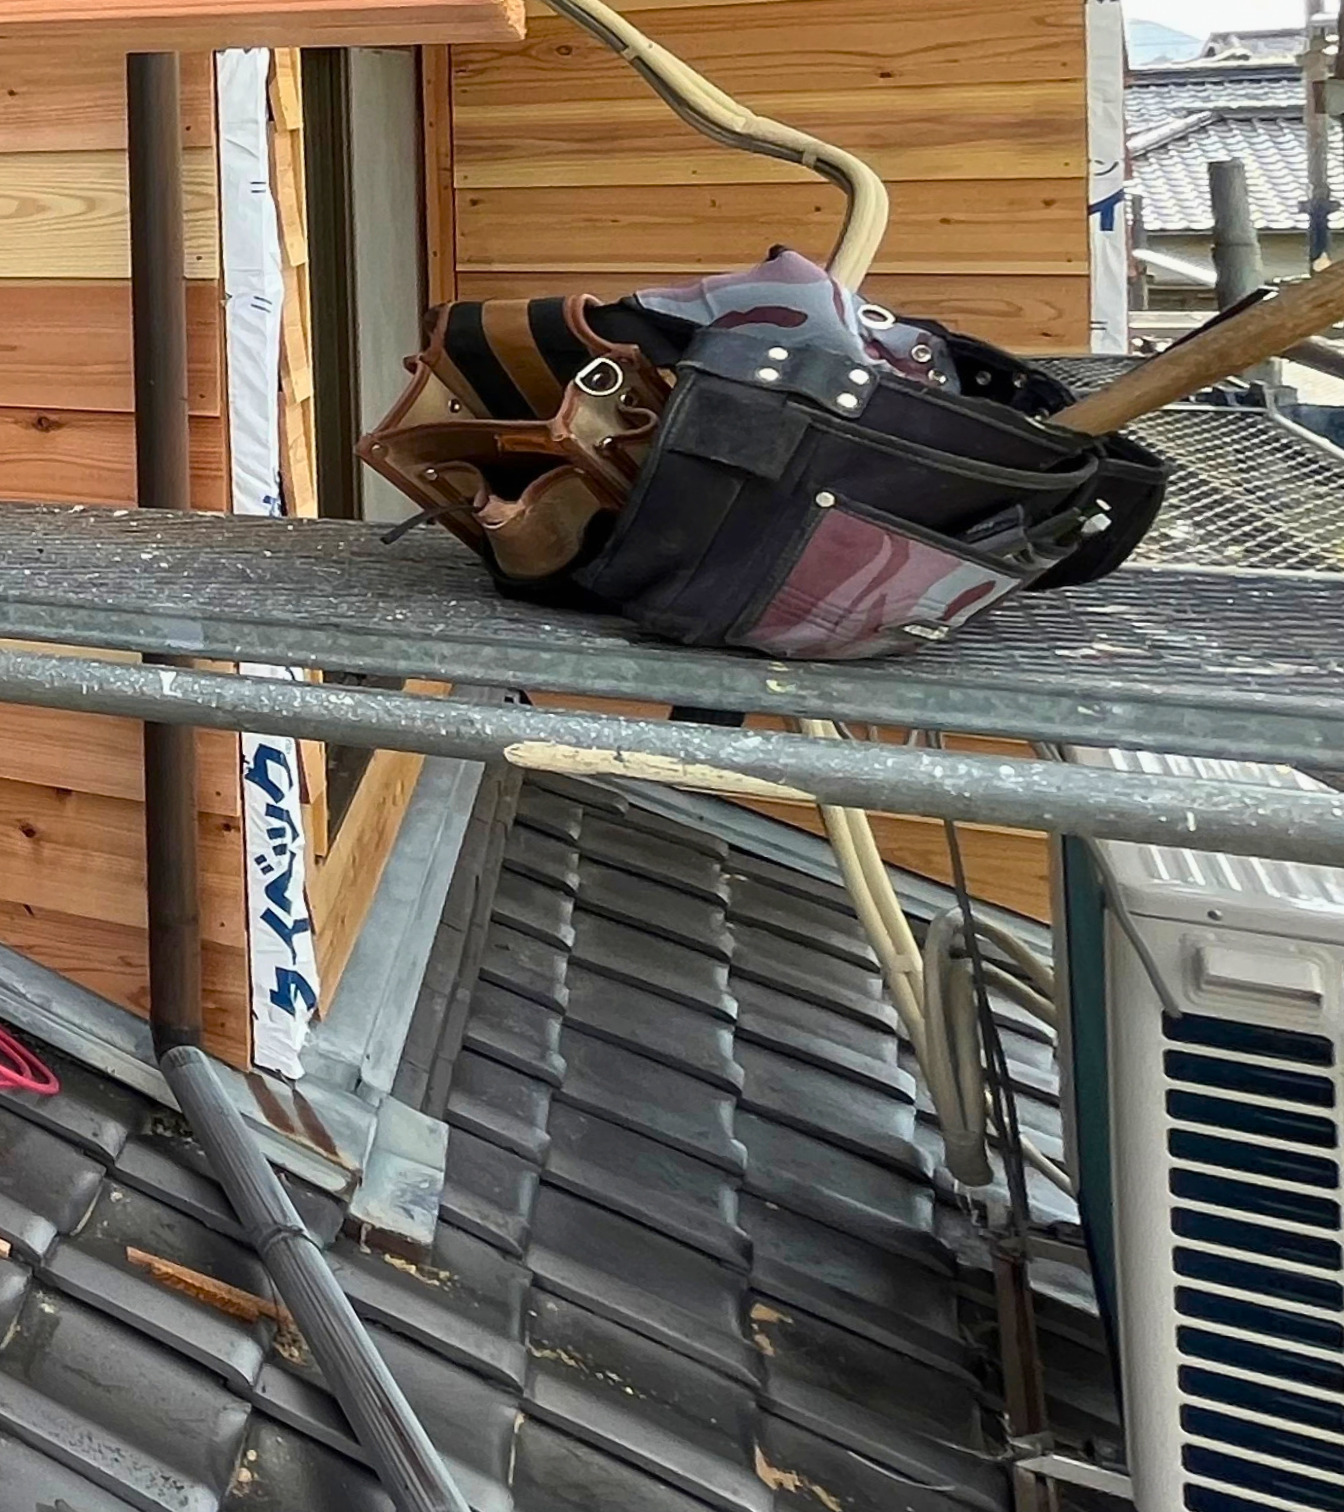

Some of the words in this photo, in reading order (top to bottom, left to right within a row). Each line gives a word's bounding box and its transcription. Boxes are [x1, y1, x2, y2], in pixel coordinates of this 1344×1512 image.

[245, 743, 317, 1016] タイベック
